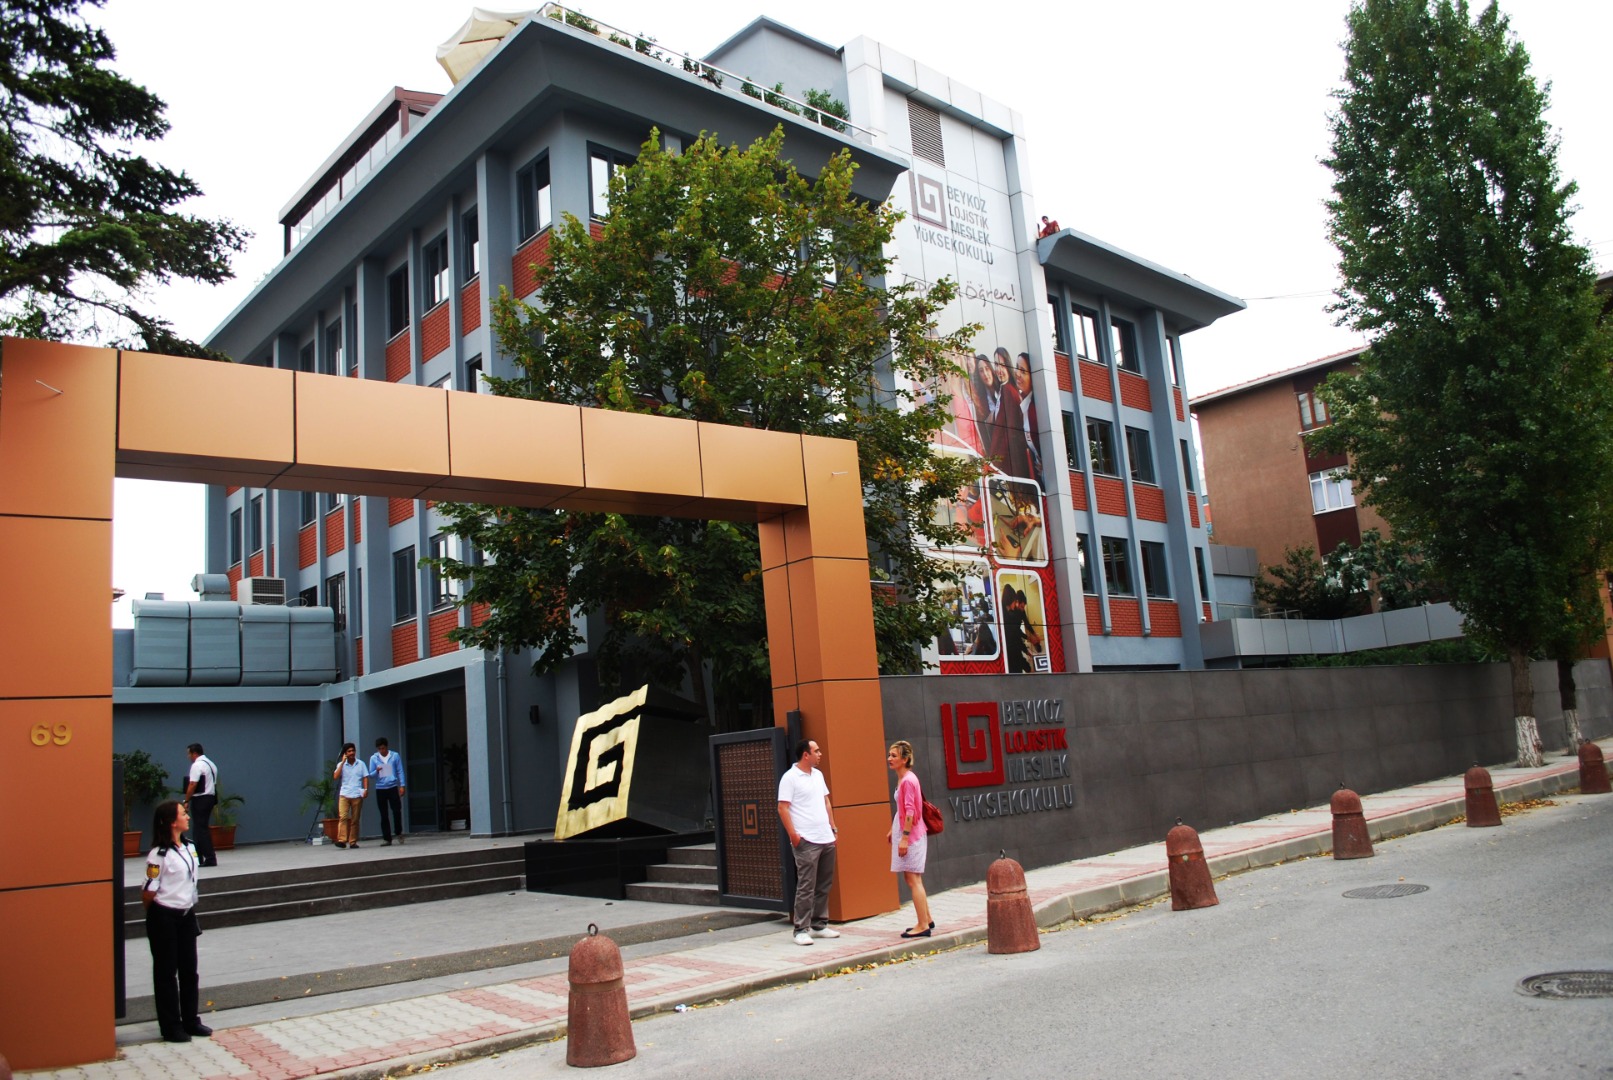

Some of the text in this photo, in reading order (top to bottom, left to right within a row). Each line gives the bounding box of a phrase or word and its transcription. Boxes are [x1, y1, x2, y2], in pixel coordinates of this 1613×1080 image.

[946, 185, 987, 213] BEYKOZ
[913, 224, 994, 265] YÜKSEKOKULU
[950, 220, 991, 247] MESLEK
[1002, 699, 1064, 725] BEYKOZ
[30, 721, 73, 747] 69
[1007, 754, 1070, 783] MESLEK
[948, 784, 1074, 822] YÜKSEKOKULU
